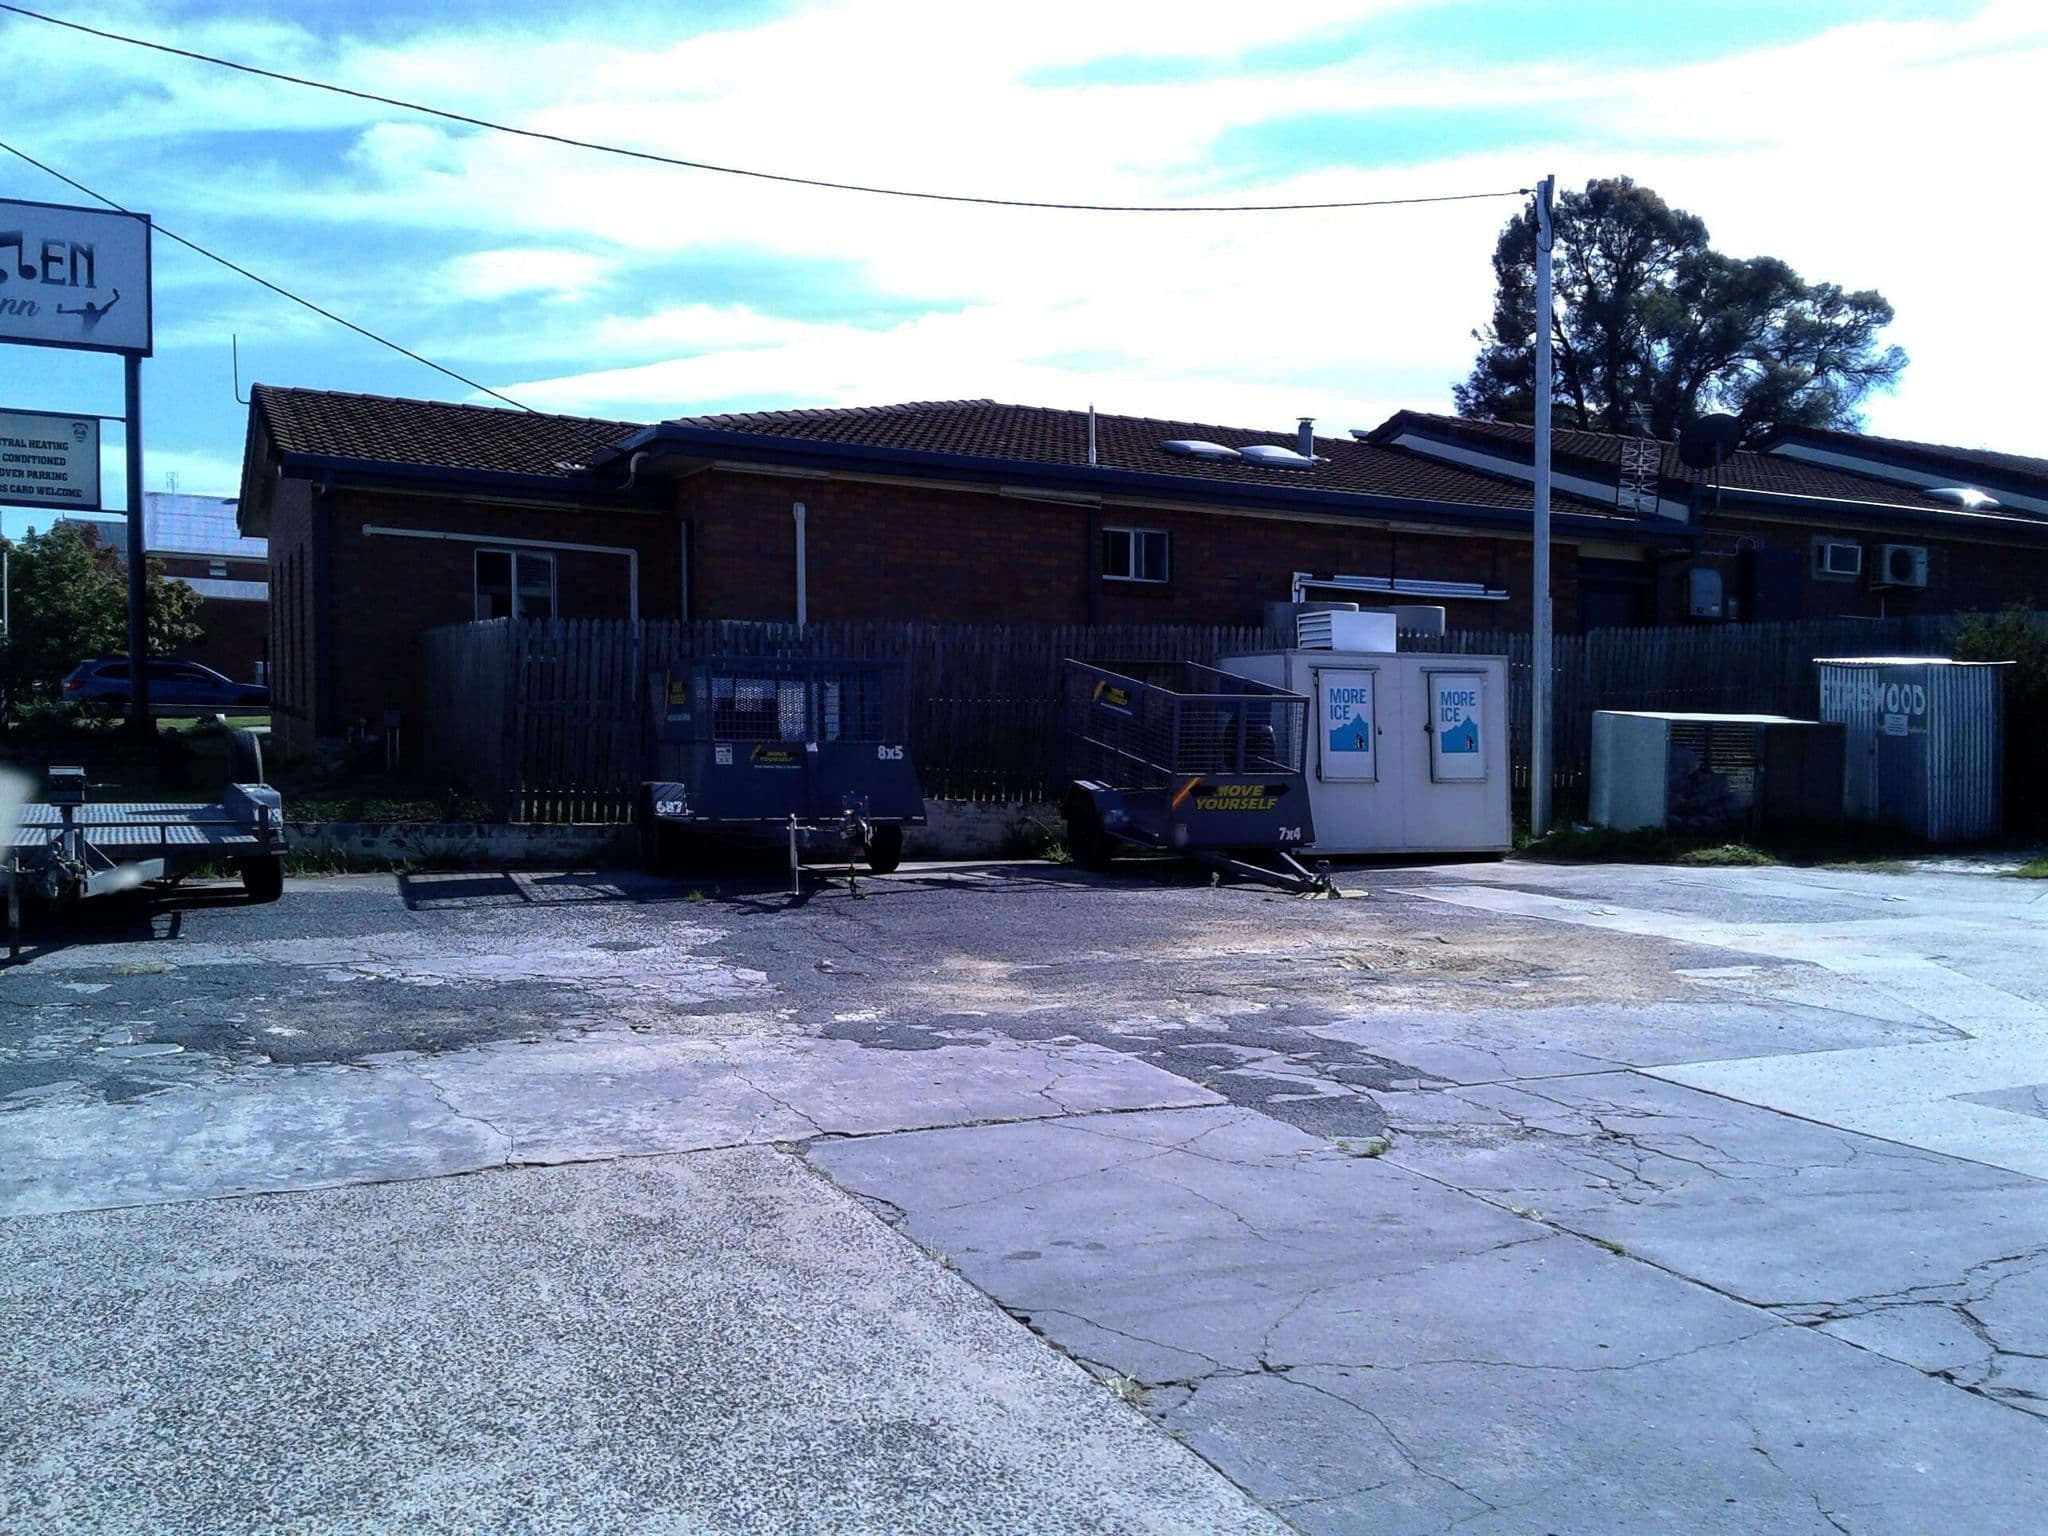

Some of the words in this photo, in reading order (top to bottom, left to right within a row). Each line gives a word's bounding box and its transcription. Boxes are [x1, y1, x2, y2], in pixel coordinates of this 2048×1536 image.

[0, 438, 26, 448] TRAL
[29, 440, 69, 451] HEATING
[2, 453, 66, 466] CONDITIONED
[26, 470, 68, 481] PARKING
[10, 485, 34, 494] CARD
[36, 486, 82, 498] WELCOME
[1329, 688, 1367, 704] MORE
[1440, 691, 1476, 706] MORE
[1820, 681, 1926, 716] FIREWOOD
[1330, 704, 1350, 720] ICE
[1441, 707, 1461, 722] ICE
[877, 745, 904, 760] 8x5
[1215, 784, 1265, 797] MOVE
[1196, 797, 1278, 810] YOURSELF
[1278, 826, 1302, 840] 7x4
